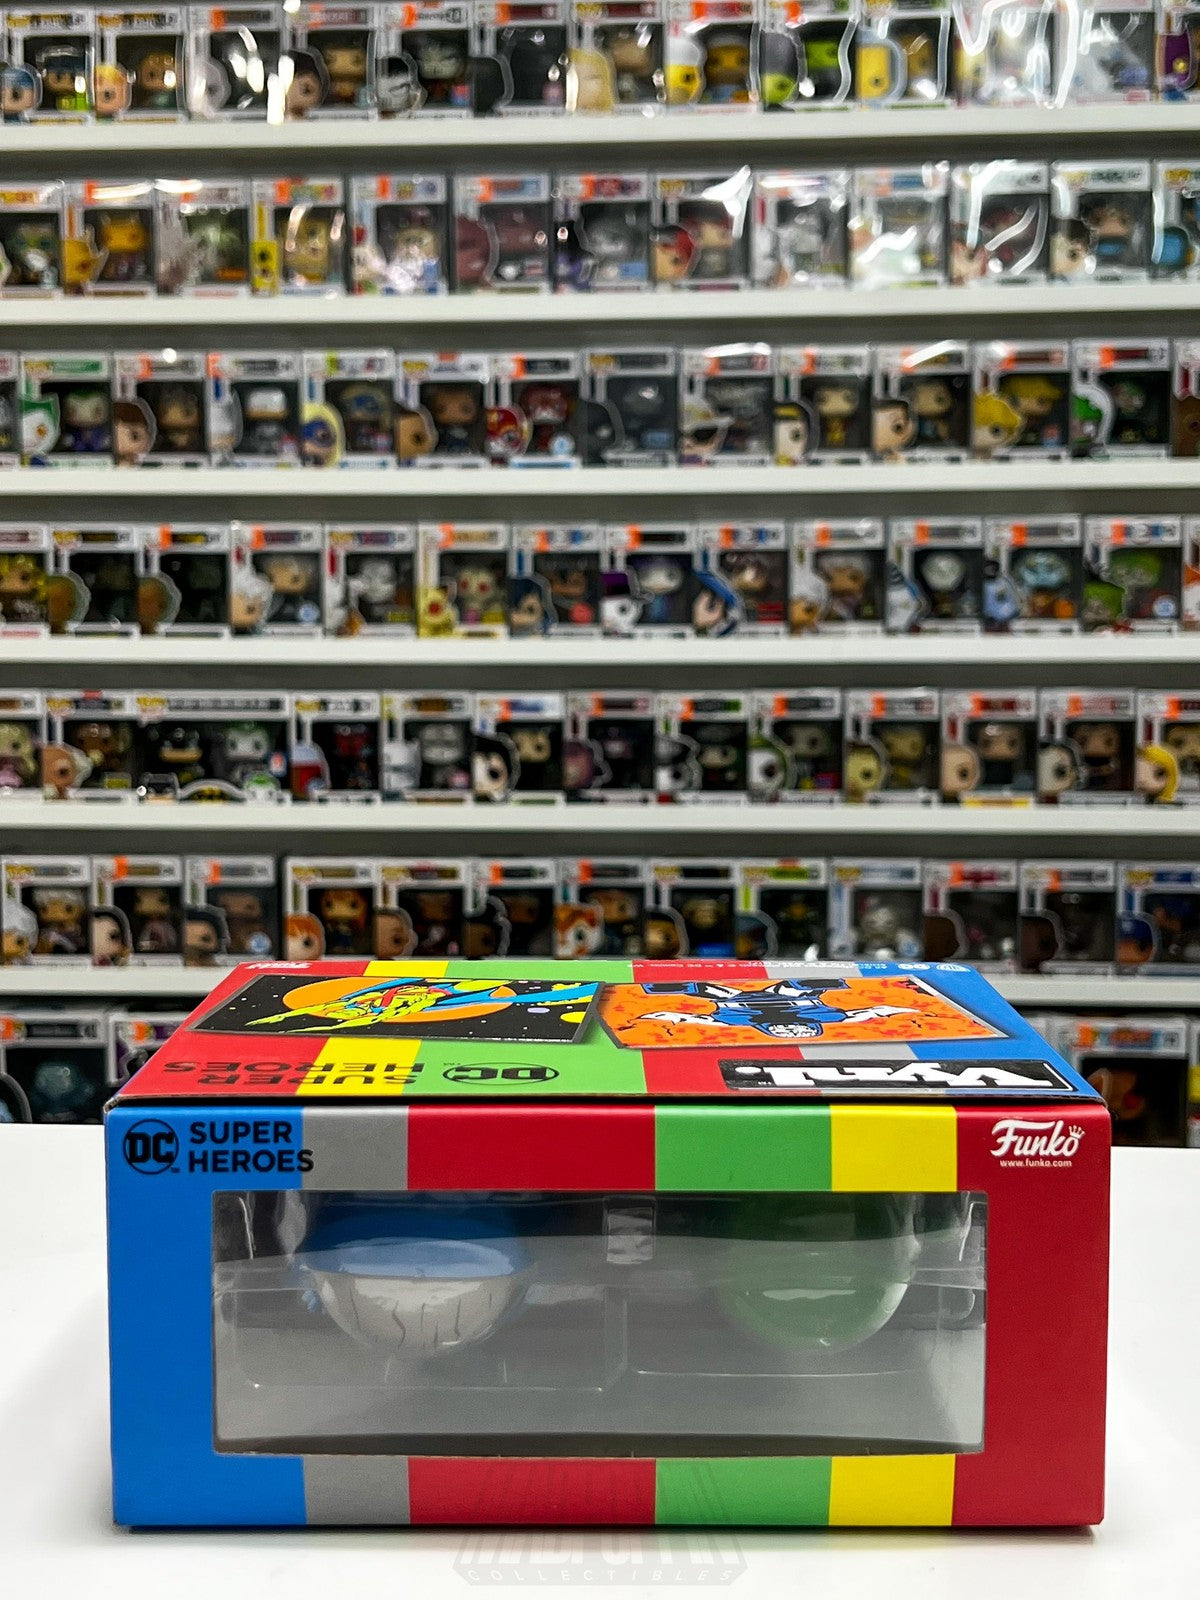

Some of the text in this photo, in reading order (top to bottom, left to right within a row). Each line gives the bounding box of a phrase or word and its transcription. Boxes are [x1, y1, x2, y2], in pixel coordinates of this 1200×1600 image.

[163, 1062, 425, 1072] HEROES
[452, 1067, 547, 1080] DC
[198, 1074, 417, 1085] SUPER
[190, 1121, 293, 1144] SUPER
[990, 1119, 1081, 1157] Funko
[125, 1131, 176, 1164] DC
[189, 1149, 315, 1173] HEROES
[1000, 1158, 1072, 1168] www.funko.com
